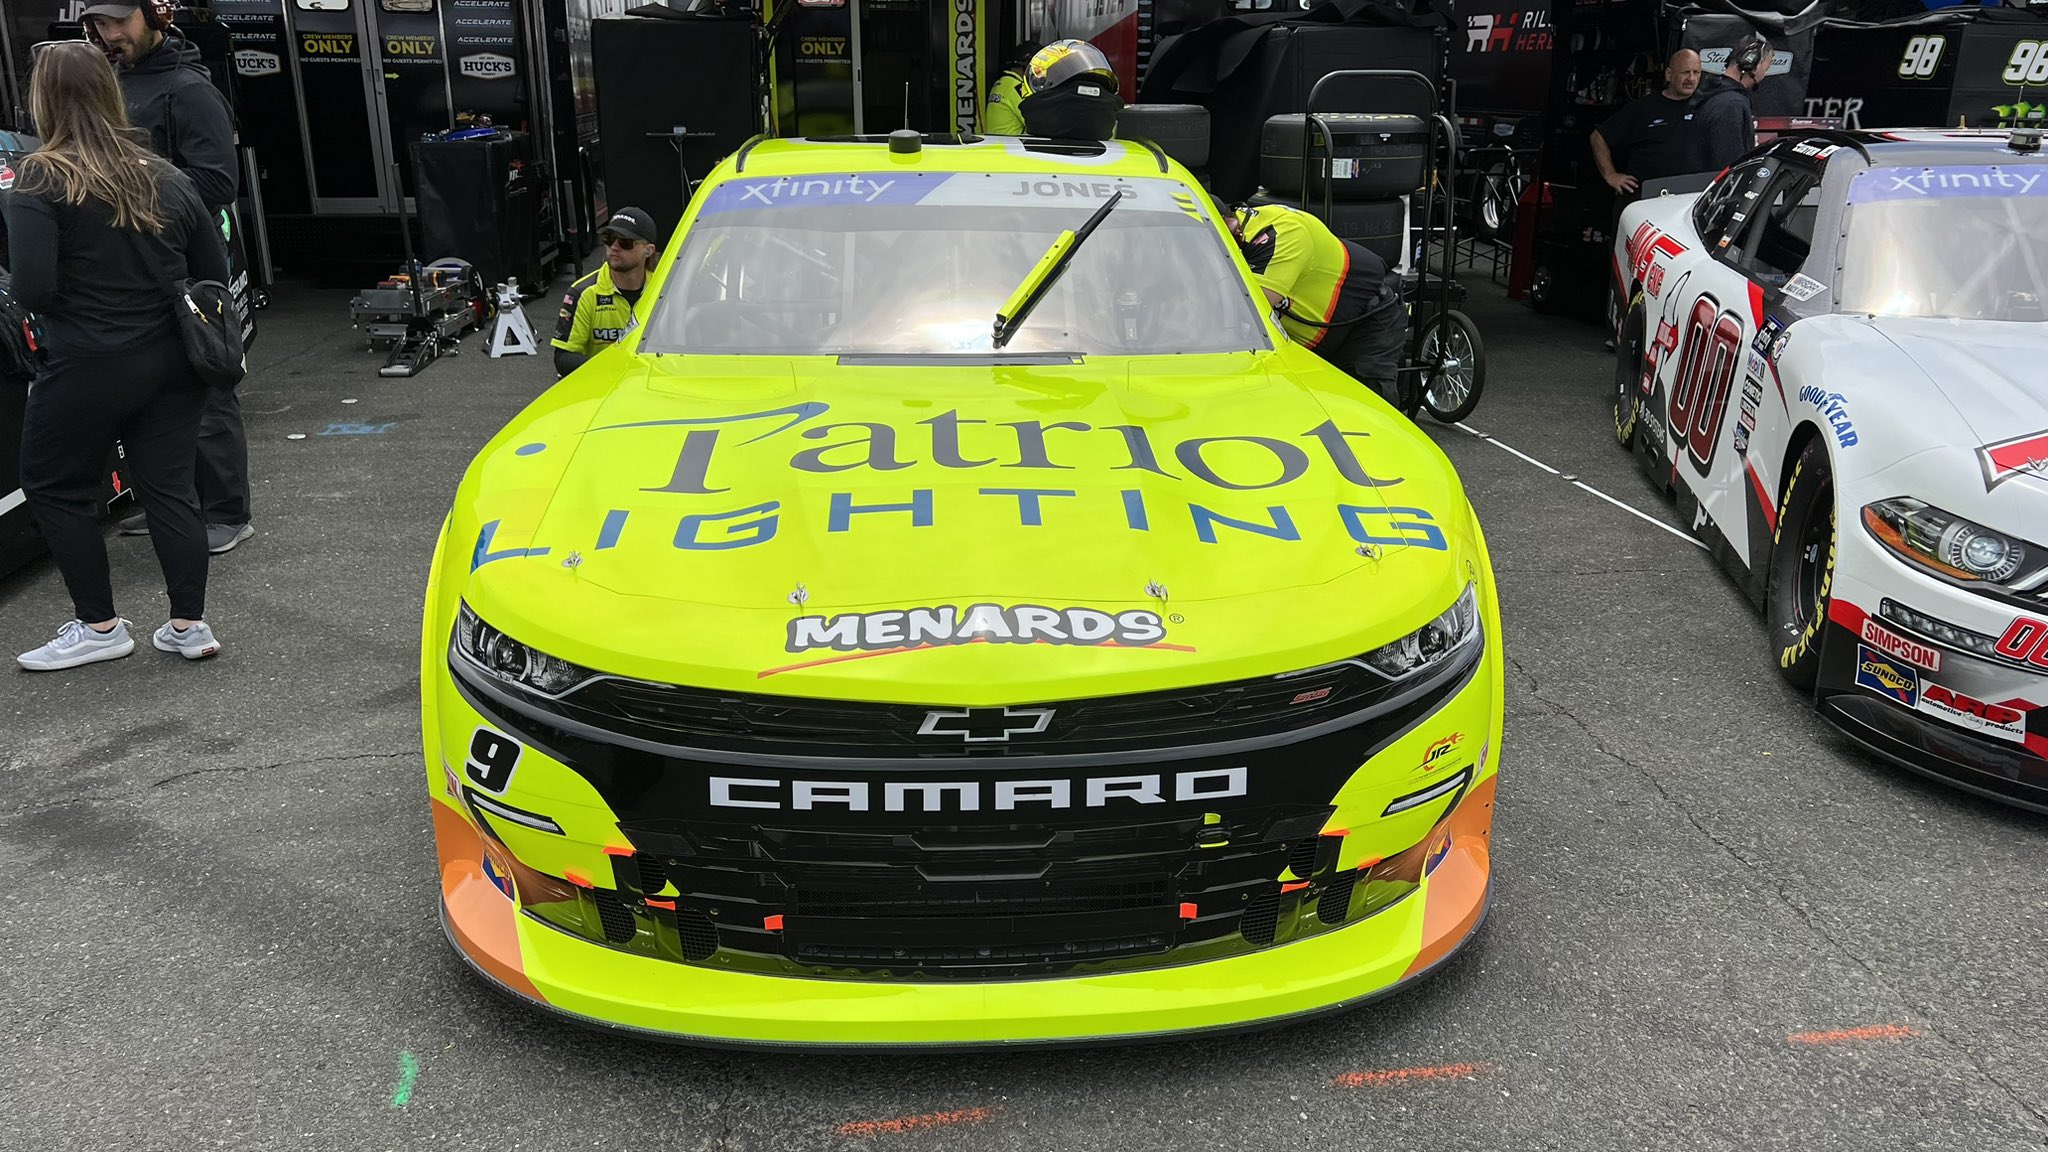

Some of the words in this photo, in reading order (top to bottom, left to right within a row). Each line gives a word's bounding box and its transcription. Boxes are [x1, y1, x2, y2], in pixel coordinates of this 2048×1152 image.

[215, 14, 275, 22] ACCELERATE
[1522, 10, 1552, 29] RIL
[303, 40, 353, 54] ONLY
[387, 41, 436, 55] ONLY
[801, 42, 845, 56] ONLY
[1899, 36, 1945, 77] 98
[237, 58, 277, 69] UCK'S
[463, 61, 512, 72] HUCK'S
[740, 176, 896, 205] xfinity
[1011, 181, 1138, 200] JONES
[1889, 169, 2041, 195] xfinity
[1668, 292, 1745, 474] 00
[575, 401, 1405, 494] Patriot
[469, 487, 1448, 576] LIGHTING
[786, 604, 1166, 652] MENARDS
[1864, 622, 1935, 669] SIMPSON
[1863, 661, 1914, 691] SUNOCO
[1920, 696, 1962, 717] automotive
[1984, 720, 2024, 736] products
[1922, 684, 2022, 724] ARP
[465, 728, 521, 793] 9
[709, 766, 1248, 812] CAMARO
